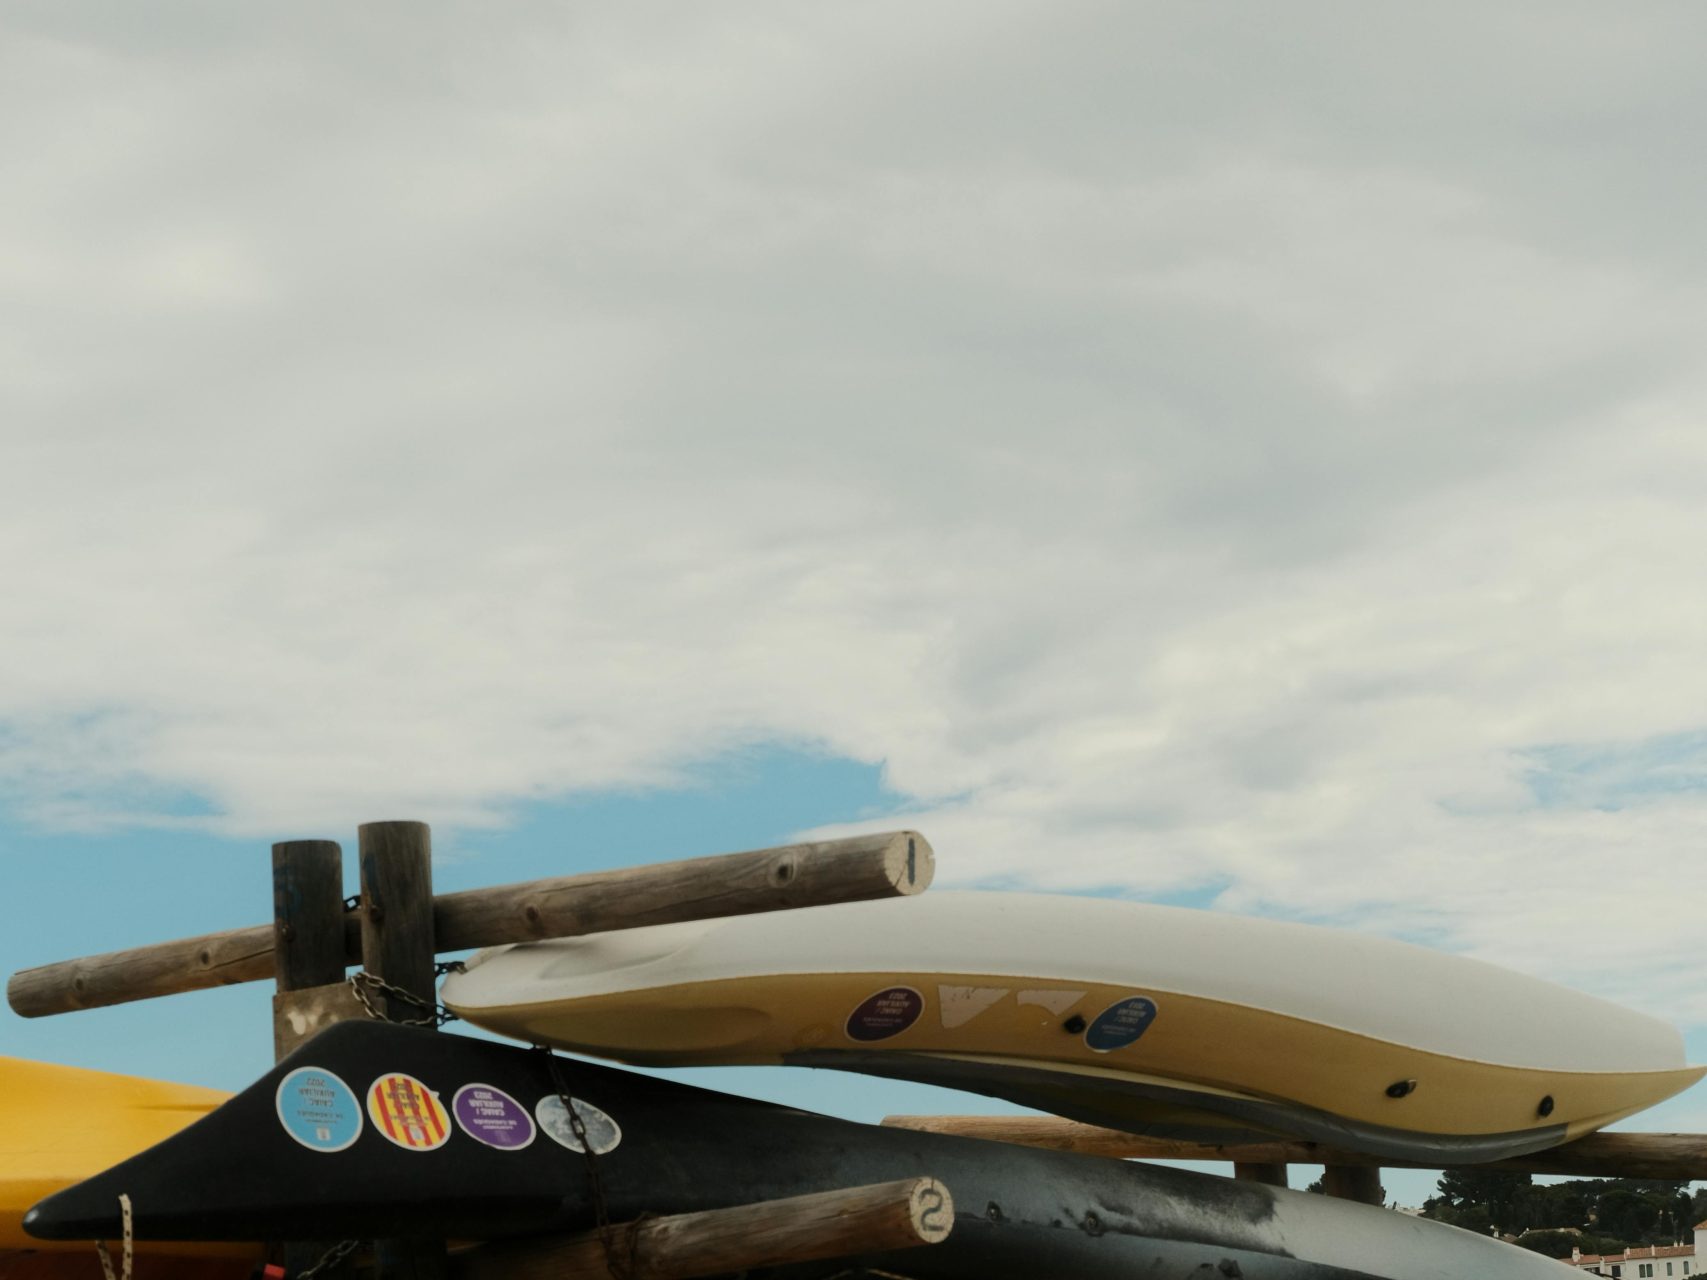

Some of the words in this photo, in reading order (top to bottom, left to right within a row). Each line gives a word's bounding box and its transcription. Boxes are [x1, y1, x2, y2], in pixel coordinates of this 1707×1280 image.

[298, 1088, 335, 1097] AUXILIAR
[468, 1099, 504, 1108] AUXILIAR
[481, 1108, 505, 1116] CAIAC
[919, 1188, 945, 1232] 2
